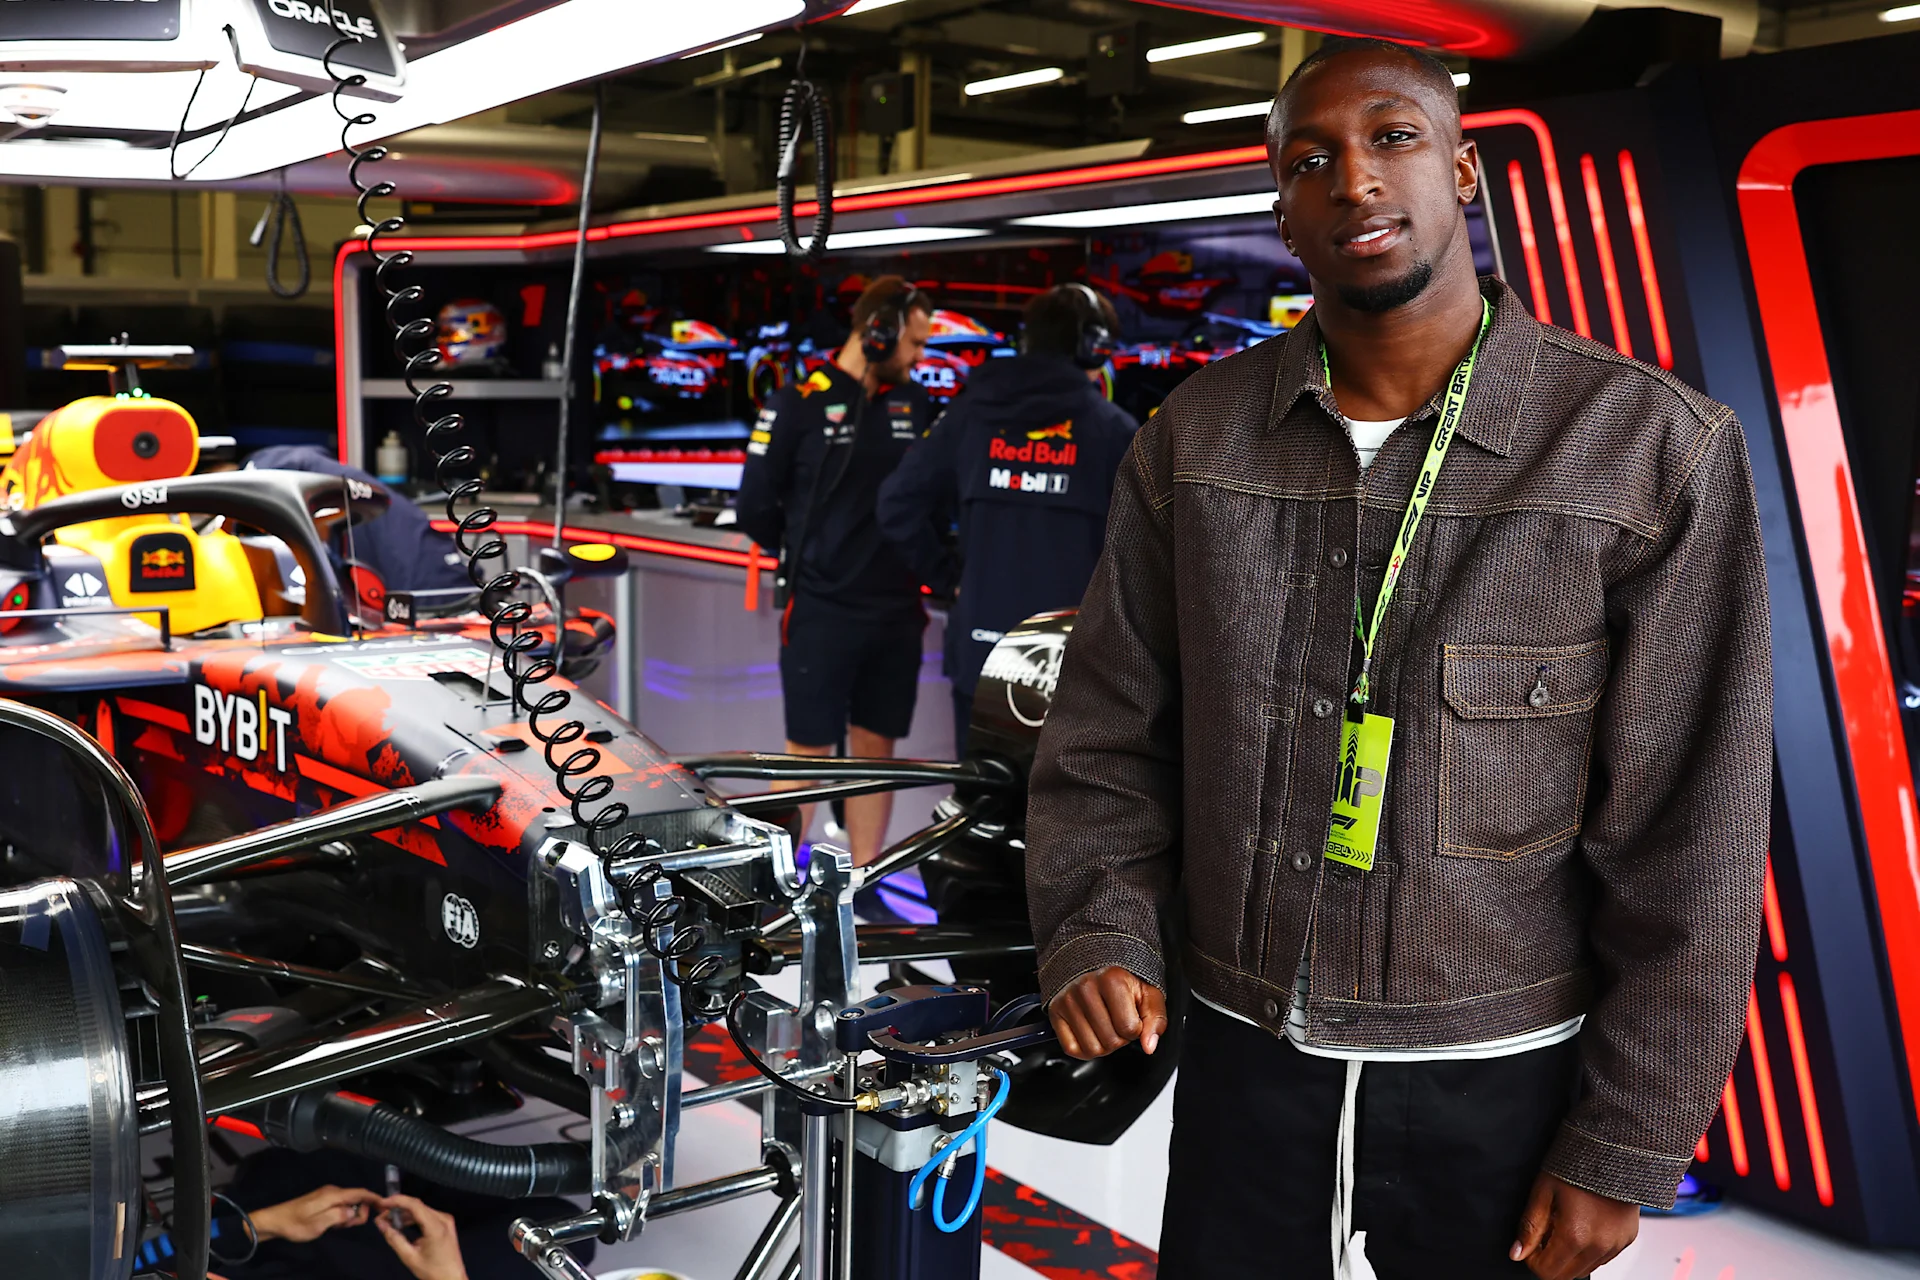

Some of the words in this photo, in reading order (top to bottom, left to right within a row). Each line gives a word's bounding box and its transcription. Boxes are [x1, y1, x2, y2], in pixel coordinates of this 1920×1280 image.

[268, 0, 378, 38] ORACLE
[1434, 395, 1460, 451] GREAT
[1451, 354, 1473, 395] BRITA
[989, 437, 1034, 462] Red
[1034, 441, 1077, 466] Bull
[989, 467, 1048, 493] Mobil
[194, 683, 292, 772] BYBIT
[1326, 842, 1351, 857] 024
[444, 901, 477, 941] FIA
